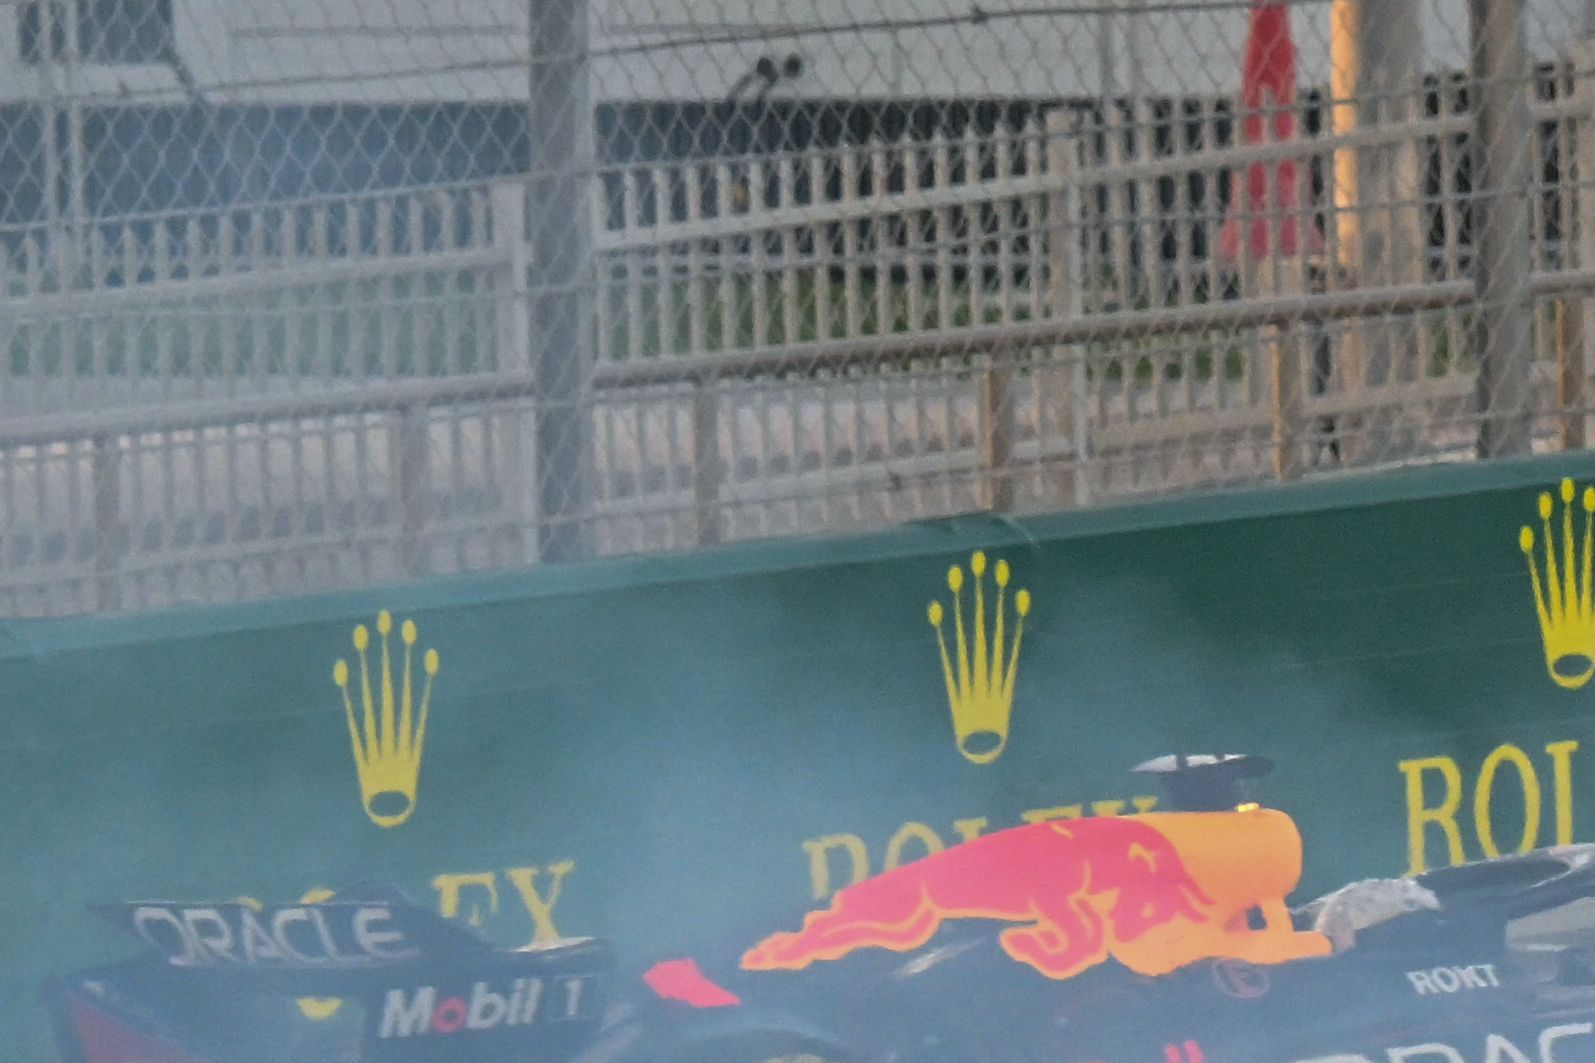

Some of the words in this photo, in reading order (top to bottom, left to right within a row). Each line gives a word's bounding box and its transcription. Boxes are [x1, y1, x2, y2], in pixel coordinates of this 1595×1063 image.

[132, 904, 418, 967] ORACLE
[379, 978, 544, 1040] Mobil
[566, 977, 586, 1018] 1
